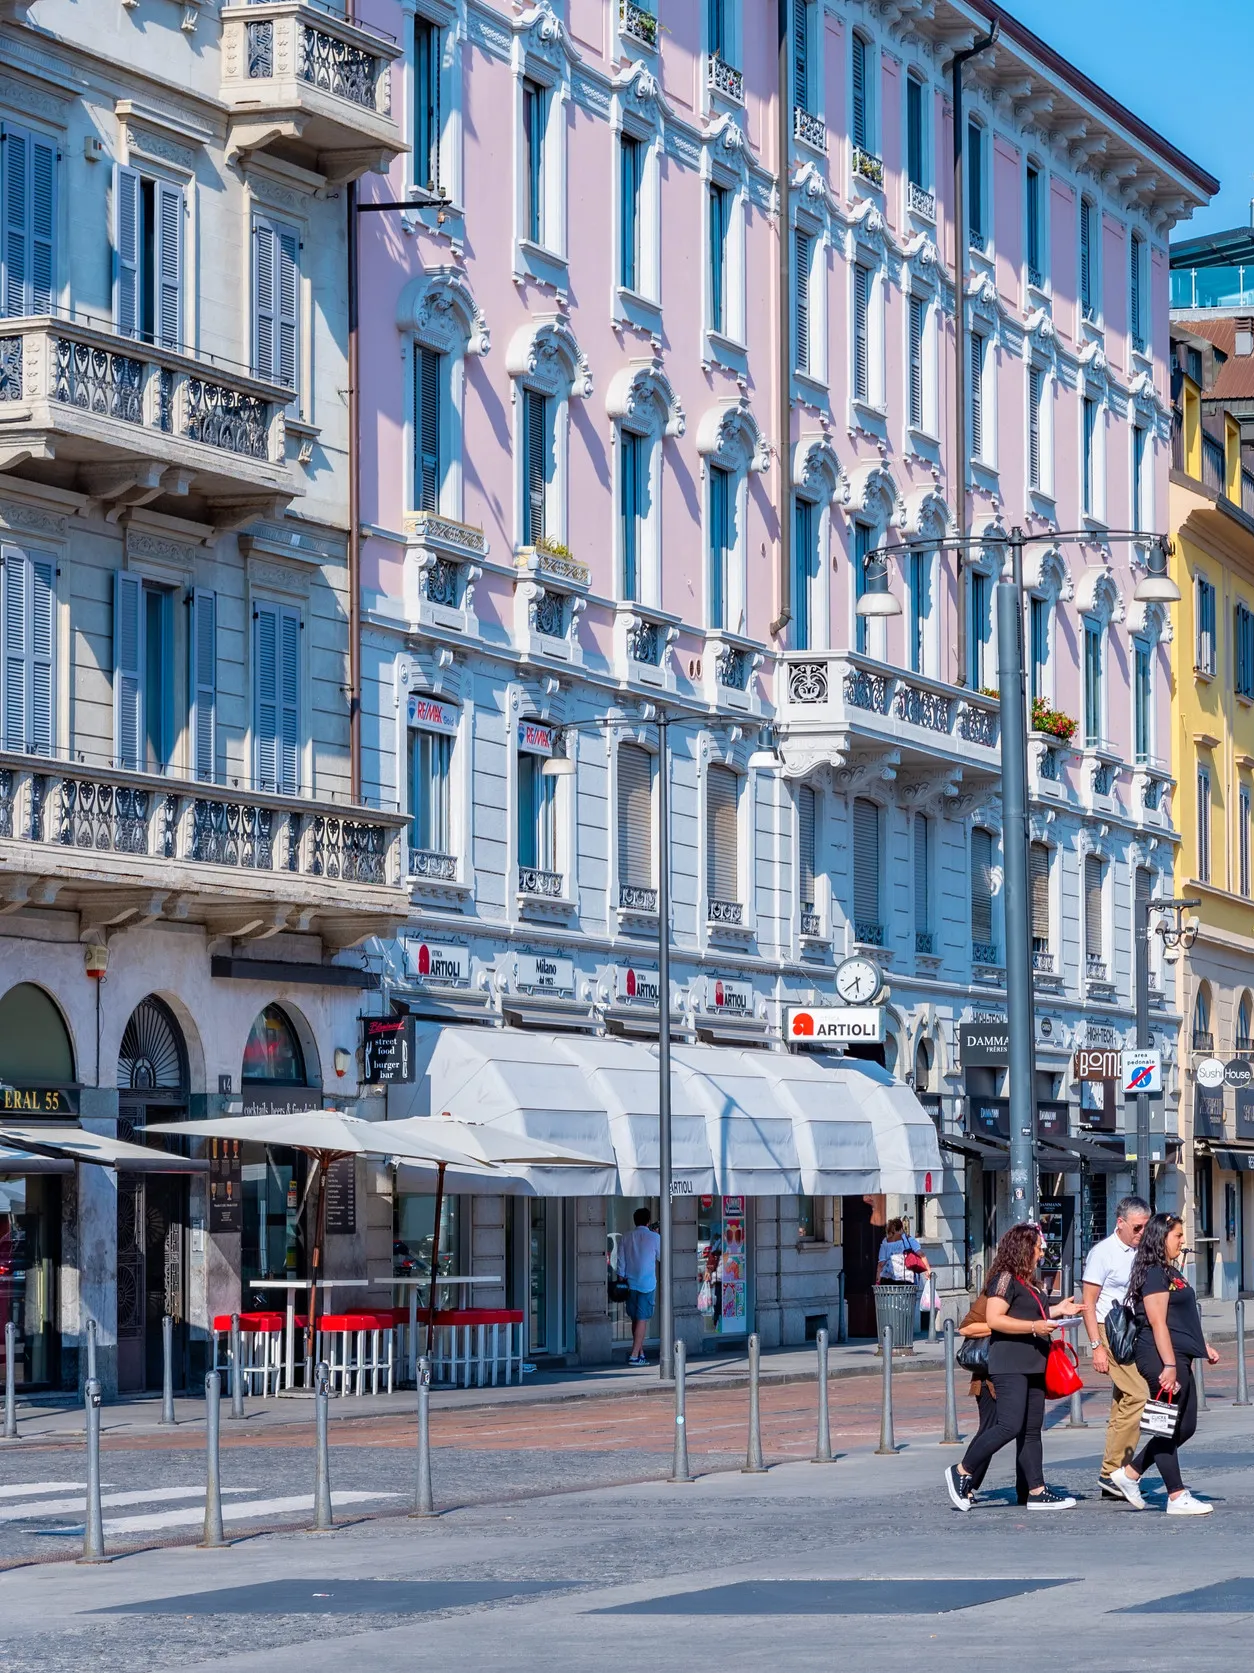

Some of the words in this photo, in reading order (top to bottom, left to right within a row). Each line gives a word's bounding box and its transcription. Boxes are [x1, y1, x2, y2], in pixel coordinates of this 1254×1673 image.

[417, 701, 442, 724] RE/MAX
[430, 959, 461, 978] ARTIOLI
[536, 958, 556, 975] Milano
[636, 981, 660, 999] ARTIOL
[724, 994, 747, 1009] ARTIOLI
[816, 1023, 876, 1037] ARTIOLI
[1086, 1026, 1114, 1043] HIGH-TECH
[966, 1035, 1009, 1047] DAMMA
[377, 1046, 395, 1055] food
[373, 1060, 400, 1071] burger
[379, 1070, 394, 1079] bar
[1199, 1067, 1224, 1079] Sushi
[1224, 1068, 1251, 1080] House
[4, 1090, 40, 1109] ERAL
[45, 1091, 59, 1110] 55
